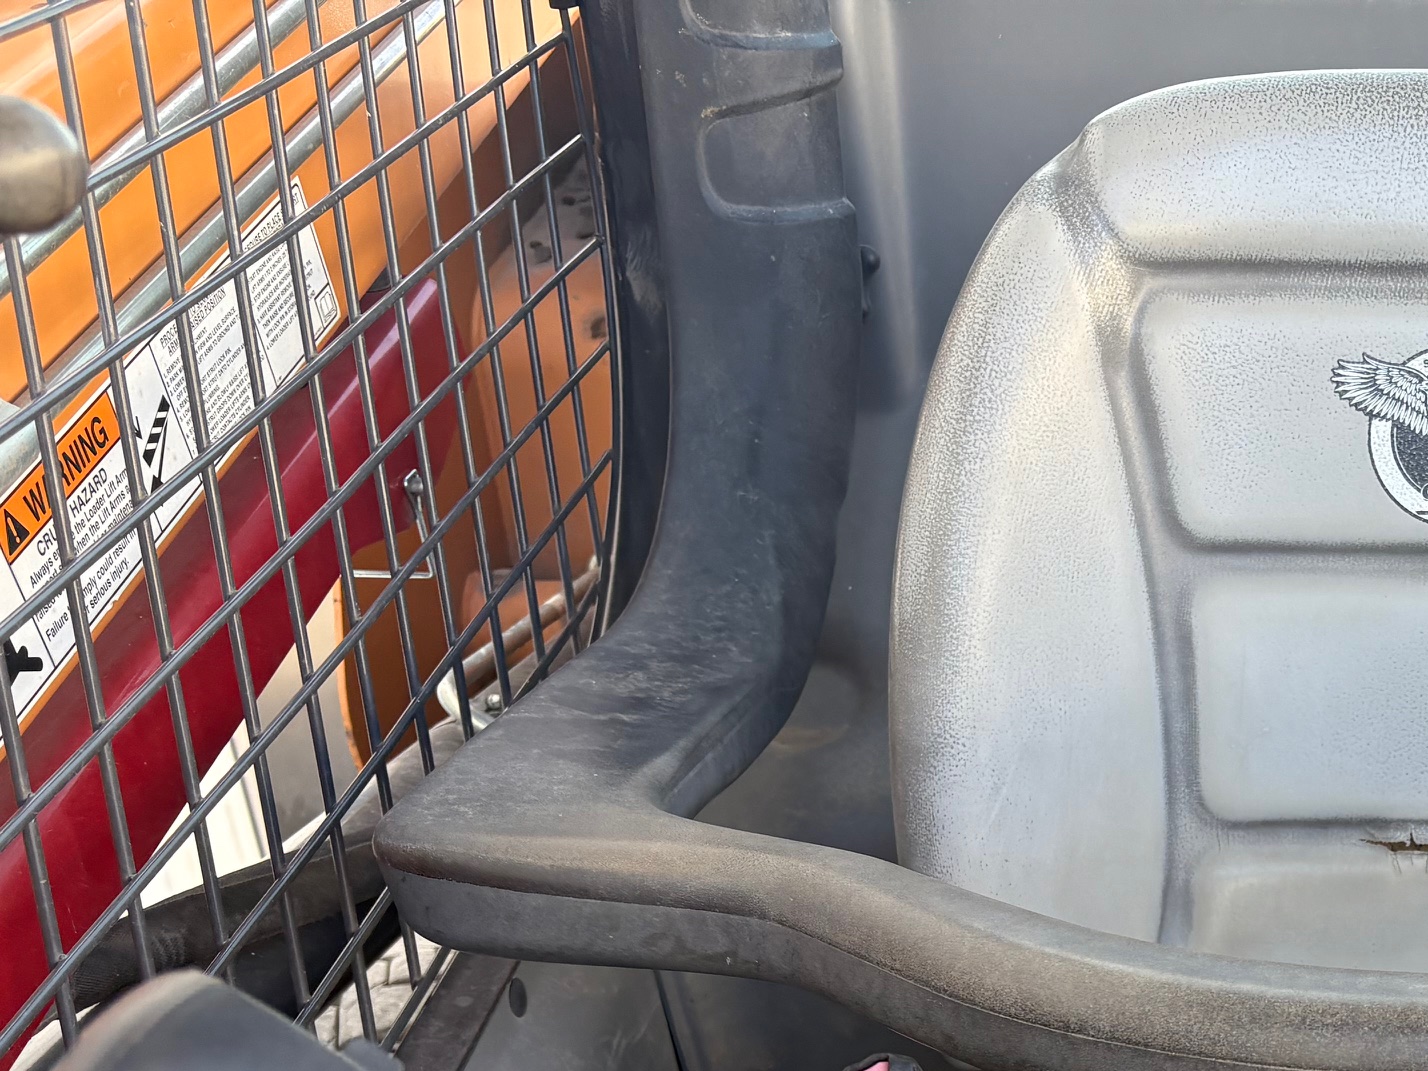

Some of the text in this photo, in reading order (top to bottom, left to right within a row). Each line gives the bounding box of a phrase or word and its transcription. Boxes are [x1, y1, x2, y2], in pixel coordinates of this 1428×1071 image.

[204, 286, 226, 315] POSITION
[22, 416, 110, 522] WRNING
[36, 527, 57, 556] CRU
[69, 467, 108, 518] HAZARD
[30, 558, 55, 588] Always
[74, 519, 86, 534] the
[84, 495, 105, 522] Loader
[104, 481, 116, 498] Lift
[89, 521, 100, 536] the
[98, 507, 111, 524] Lift
[110, 491, 125, 512] Arms
[46, 613, 68, 641] Failure
[97, 554, 114, 579] could
[90, 579, 111, 609] serious
[110, 558, 129, 582] injury.
